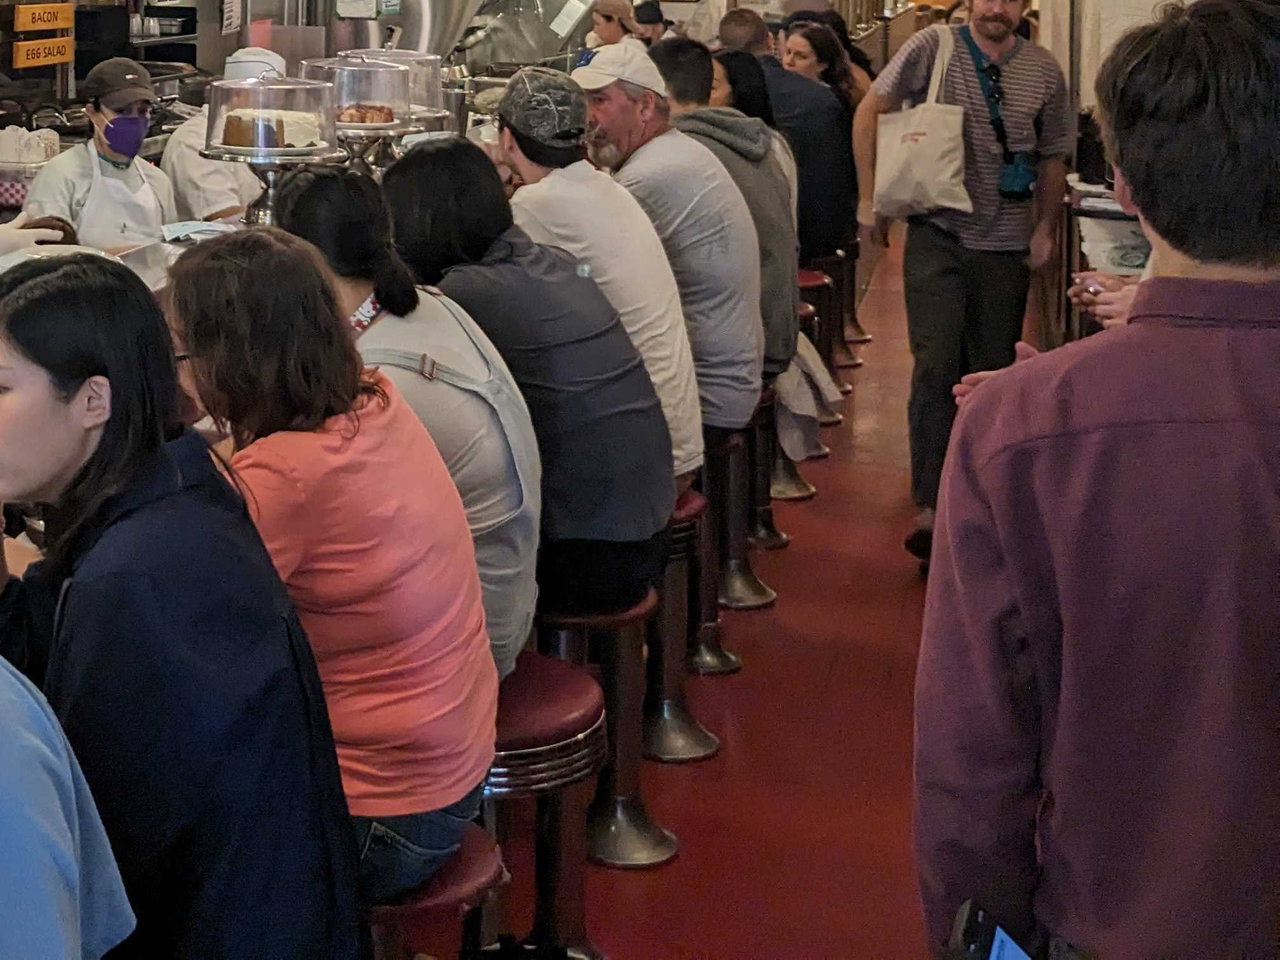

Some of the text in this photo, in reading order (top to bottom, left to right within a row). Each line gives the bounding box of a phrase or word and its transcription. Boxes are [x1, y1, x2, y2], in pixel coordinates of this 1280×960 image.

[31, 11, 59, 24] BACON
[26, 45, 67, 60] EGG SALAD
